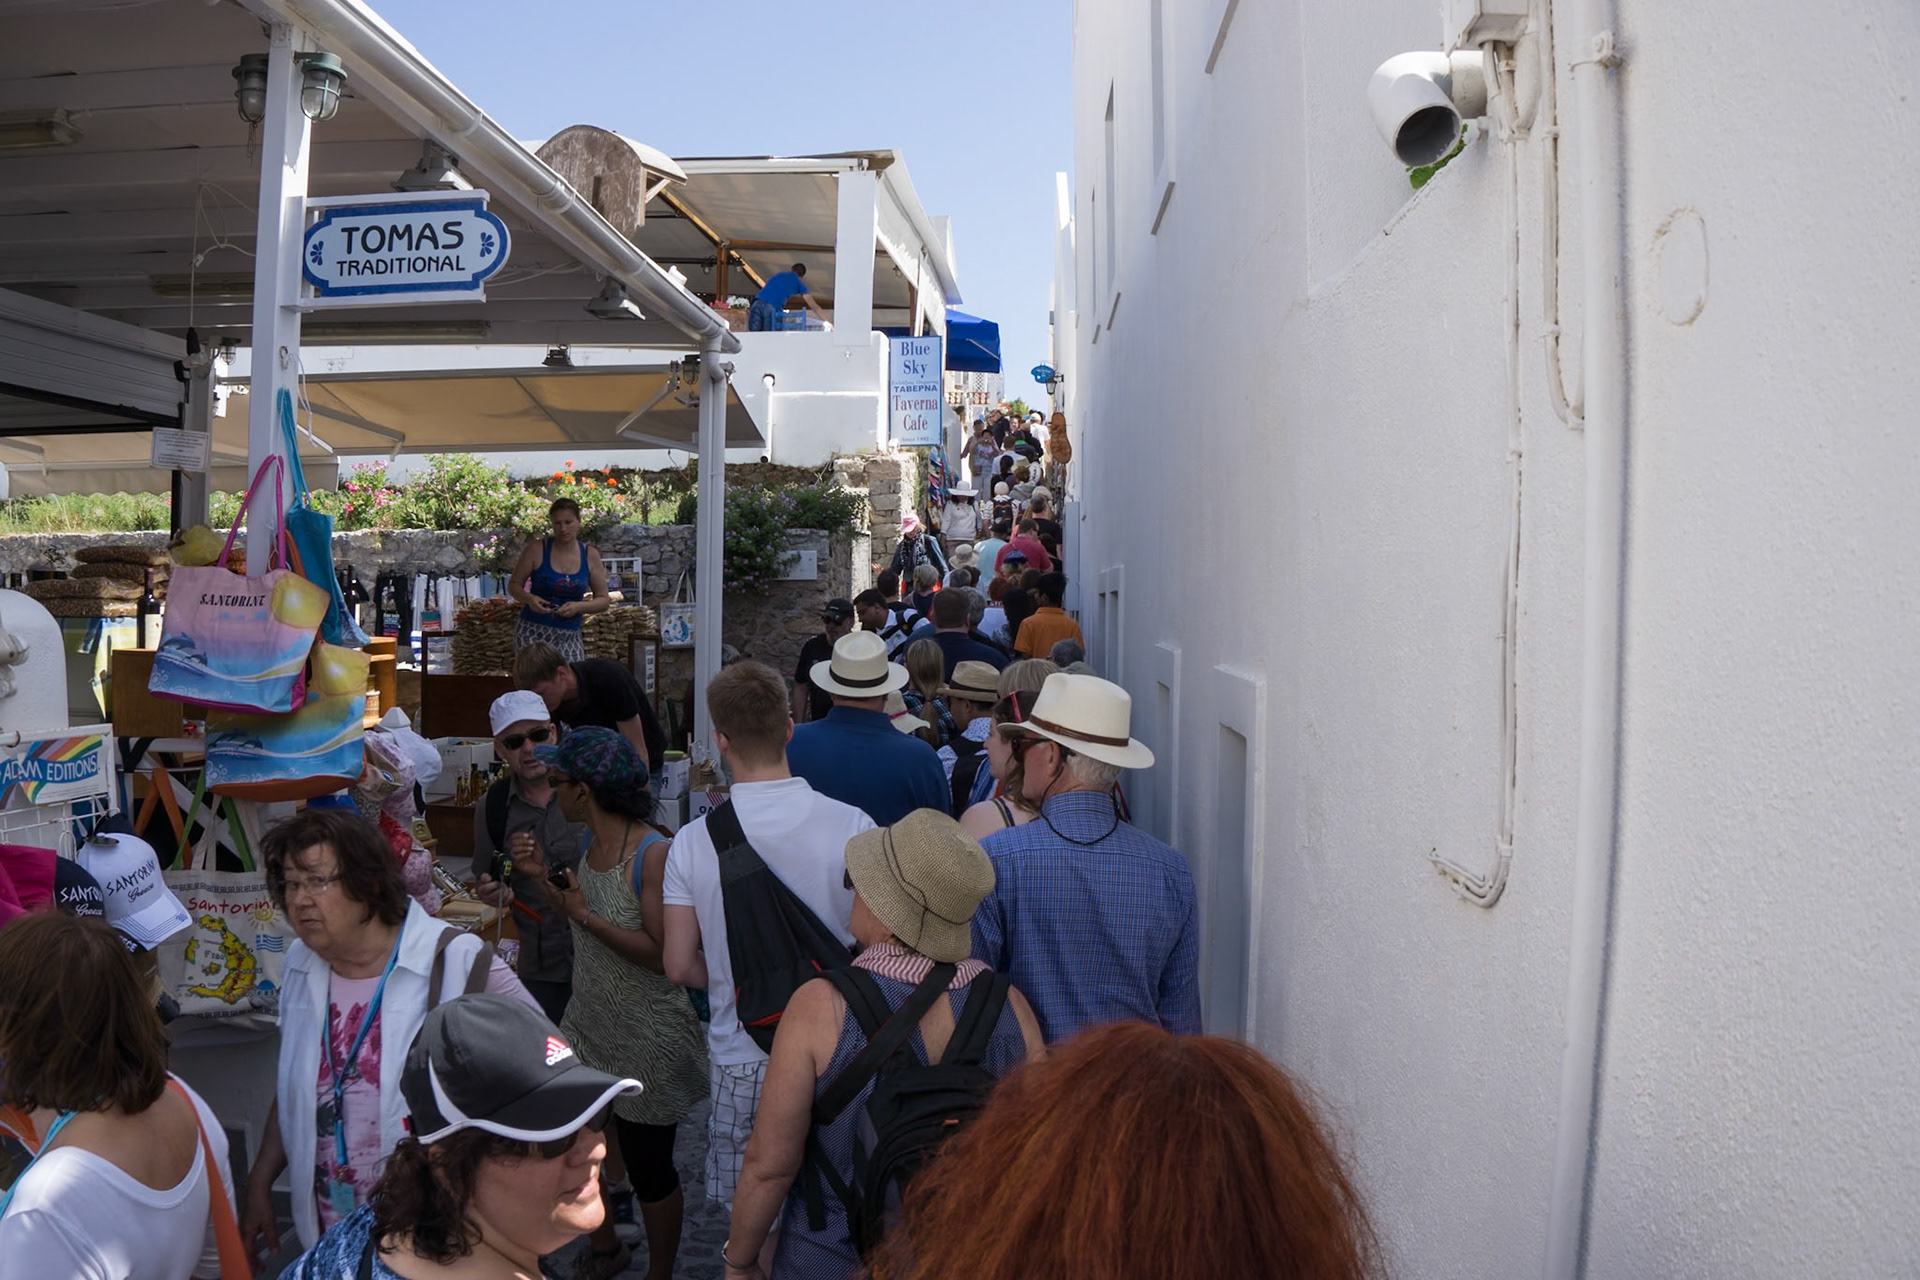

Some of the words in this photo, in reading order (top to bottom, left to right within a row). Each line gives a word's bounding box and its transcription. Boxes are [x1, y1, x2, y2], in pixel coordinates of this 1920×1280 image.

[341, 221, 464, 254] TOMAS
[336, 255, 466, 277] TRADITIONAL
[901, 341, 930, 356] Blue
[903, 359, 928, 378] Sky
[893, 394, 938, 411] Taverna
[2, 760, 43, 785] ADAM
[46, 755, 97, 781] EDITIONS
